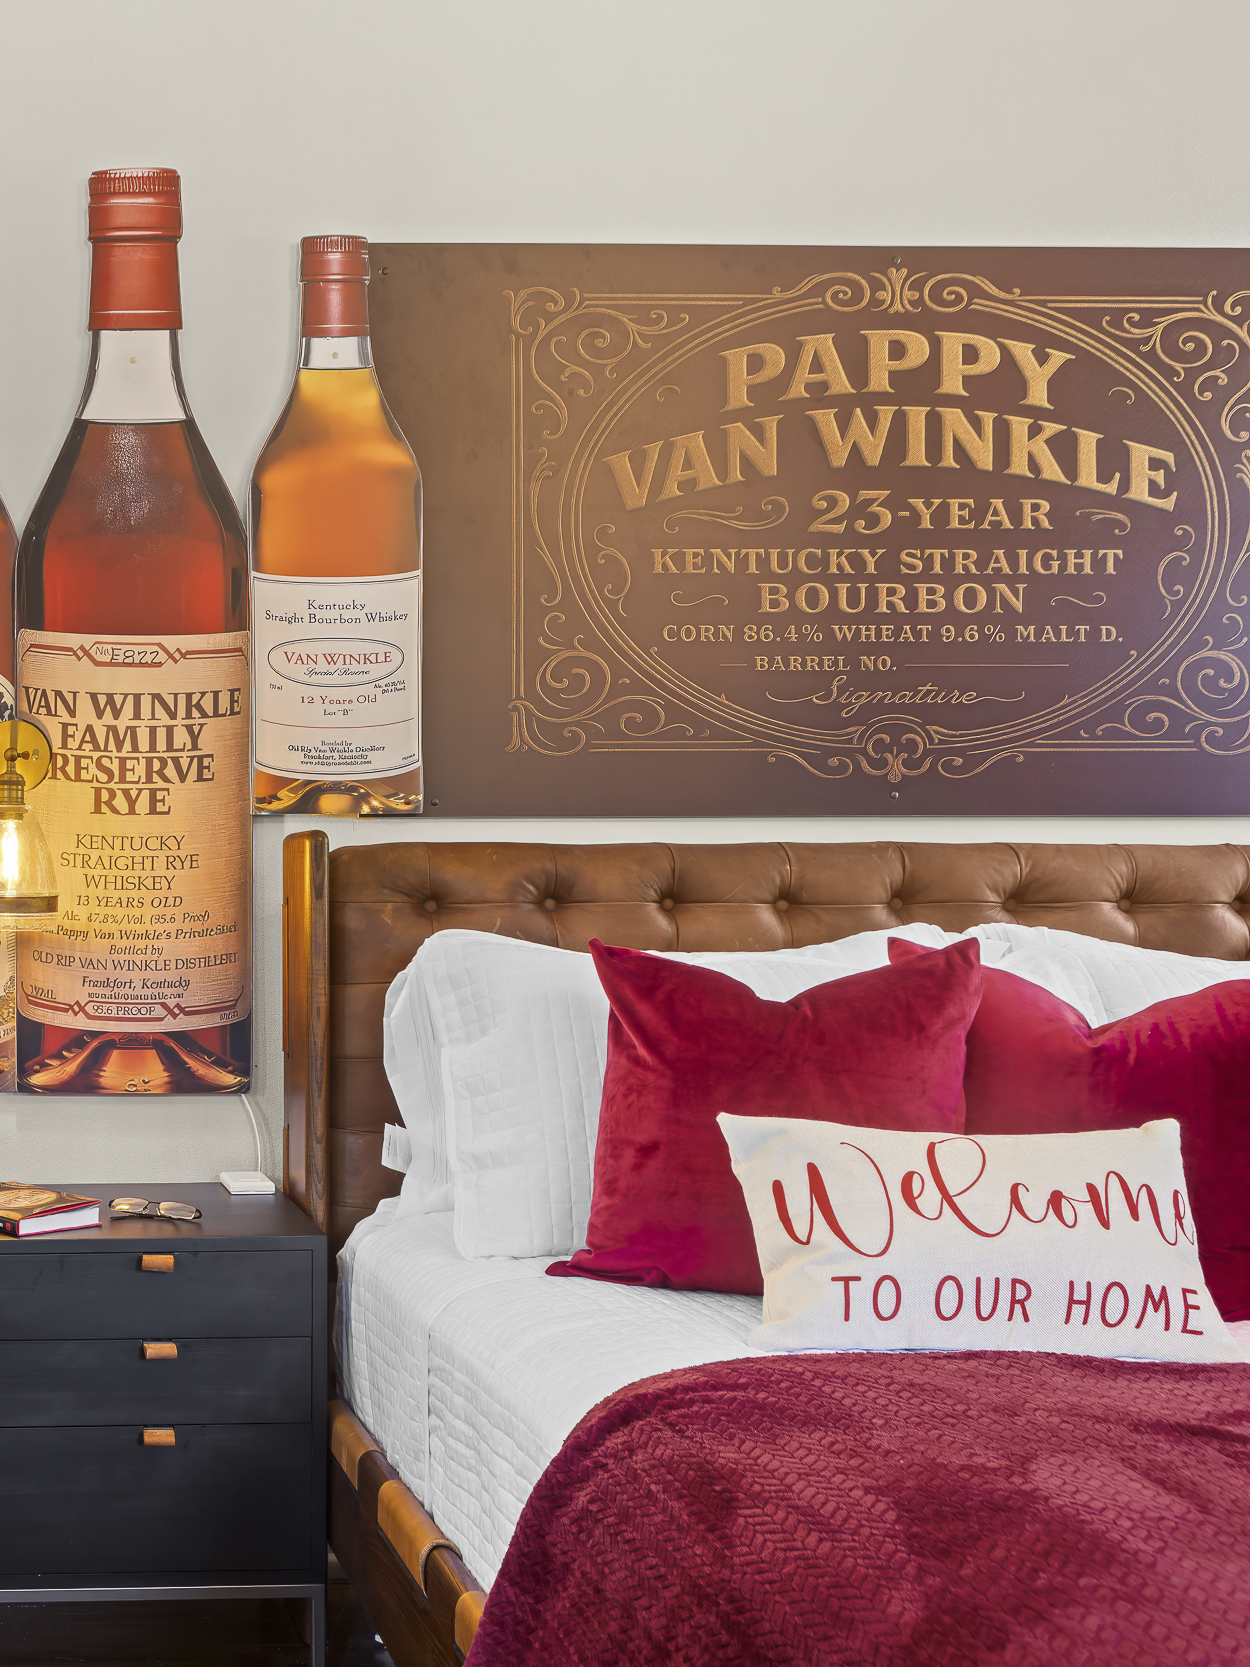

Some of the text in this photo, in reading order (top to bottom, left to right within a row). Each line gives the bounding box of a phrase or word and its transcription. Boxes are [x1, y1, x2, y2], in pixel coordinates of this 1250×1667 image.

[719, 329, 1077, 412] PAPPY
[603, 405, 1179, 513] VAN WINKLE
[806, 489, 1054, 535] 23-YEAR
[651, 547, 1125, 576] KENTUCKY STRAIGHT
[307, 599, 367, 611] Kentucky
[756, 582, 1029, 615] BOURBON
[264, 609, 409, 626] Straight Bourbon Whiskey
[662, 624, 1125, 644] CORN 86.4% WHEAT 9.6% MALT D.
[282, 650, 393, 667] VAN WINKLE
[753, 655, 898, 673] BARREL NO.
[22, 685, 242, 721] VAN WINKLE
[300, 694, 378, 706] 12 Years Old
[810, 675, 990, 717] Signature
[57, 721, 209, 754] FAMILY
[48, 753, 215, 785] RESERVE
[89, 786, 172, 816] RYE
[75, 833, 186, 851] KENTUCKY
[60, 852, 200, 872] STRAIGHT RYE
[82, 873, 176, 891] WHISKEY
[76, 895, 183, 909] 13 YEARS OLD
[56, 924, 90, 942] Pappy
[55, 953, 77, 968] RIP
[78, 956, 109, 972] VAN
[112, 959, 172, 972] WINKLE
[771, 1136, 1197, 1259] Welcome
[831, 1273, 1205, 1337] TO OUR HOME
